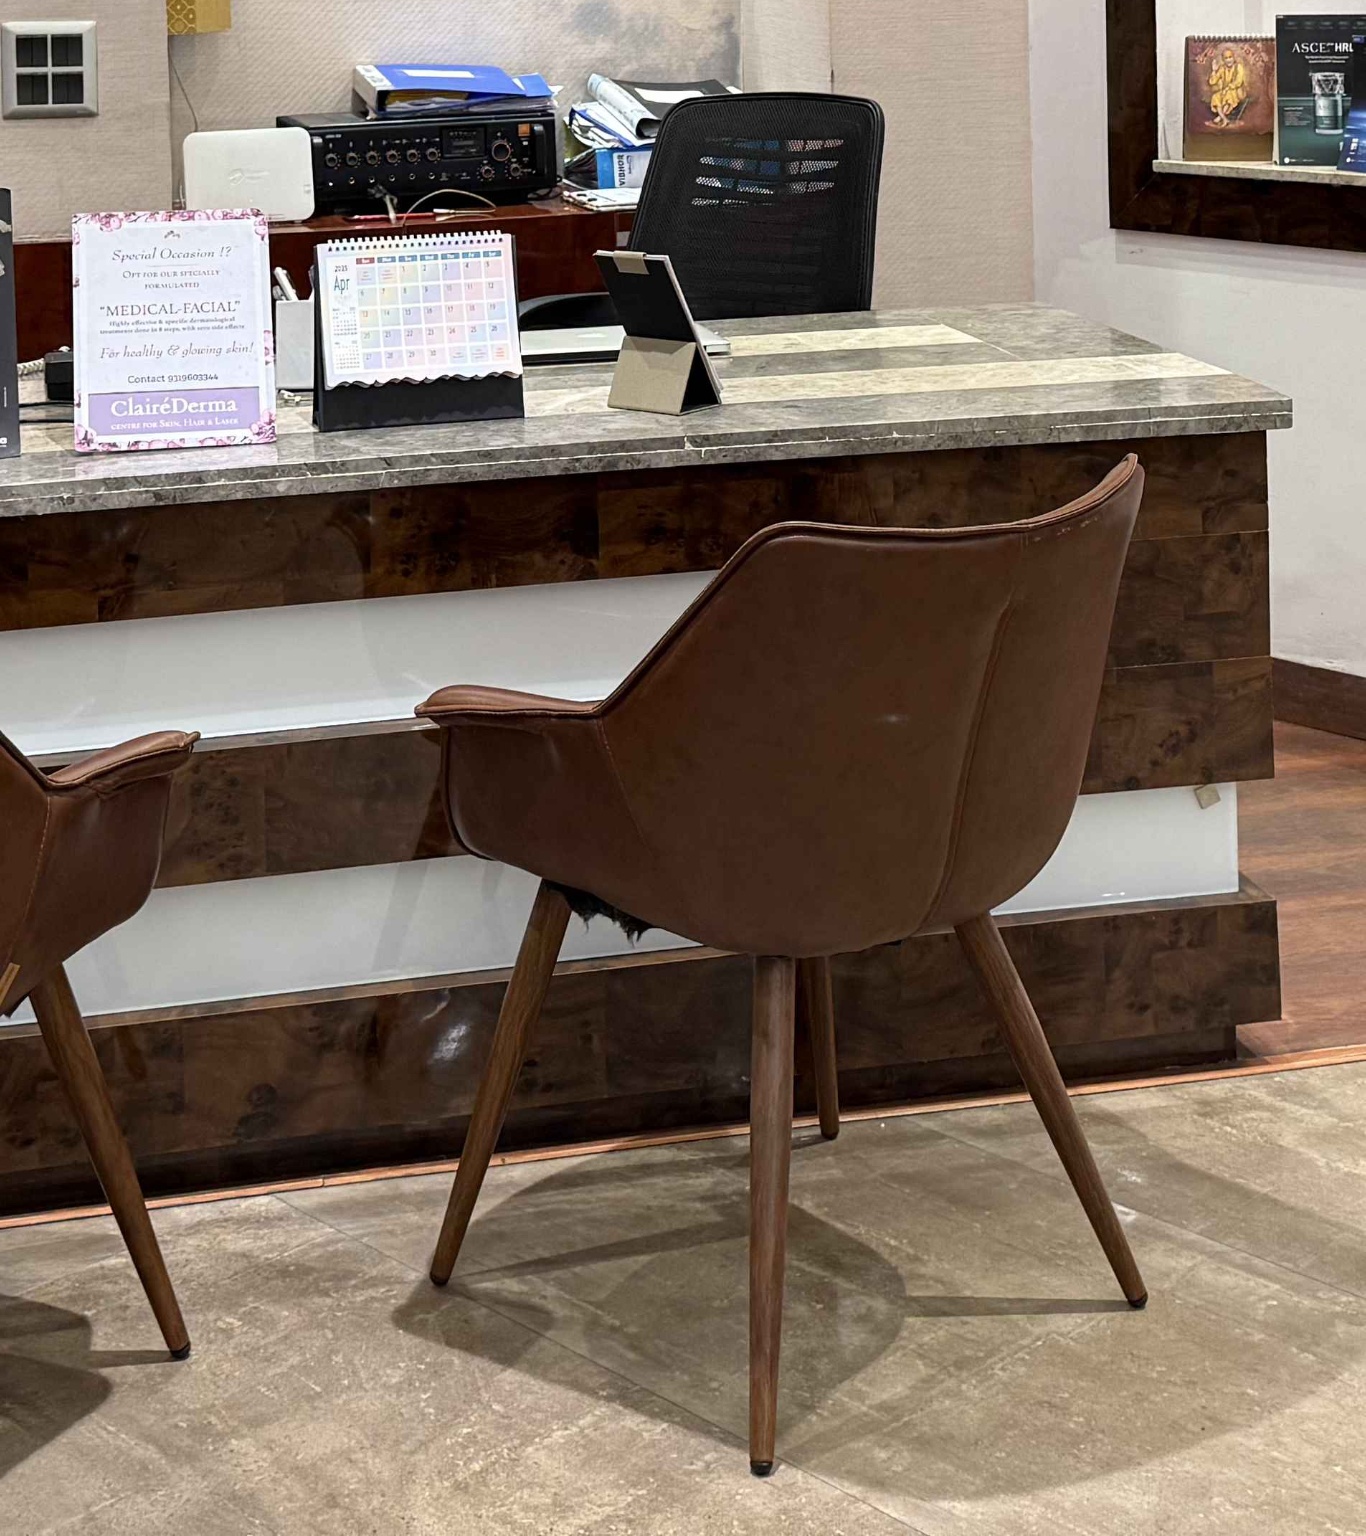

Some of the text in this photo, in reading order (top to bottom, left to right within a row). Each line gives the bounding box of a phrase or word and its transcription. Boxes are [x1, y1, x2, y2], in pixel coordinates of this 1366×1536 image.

[112, 247, 157, 263] Special
[160, 247, 215, 261] Occasion
[334, 275, 350, 295] Apr
[100, 340, 254, 359] For healthy & glowing skin!
[128, 373, 165, 384] Contact
[111, 396, 238, 417] ClairéDerma
